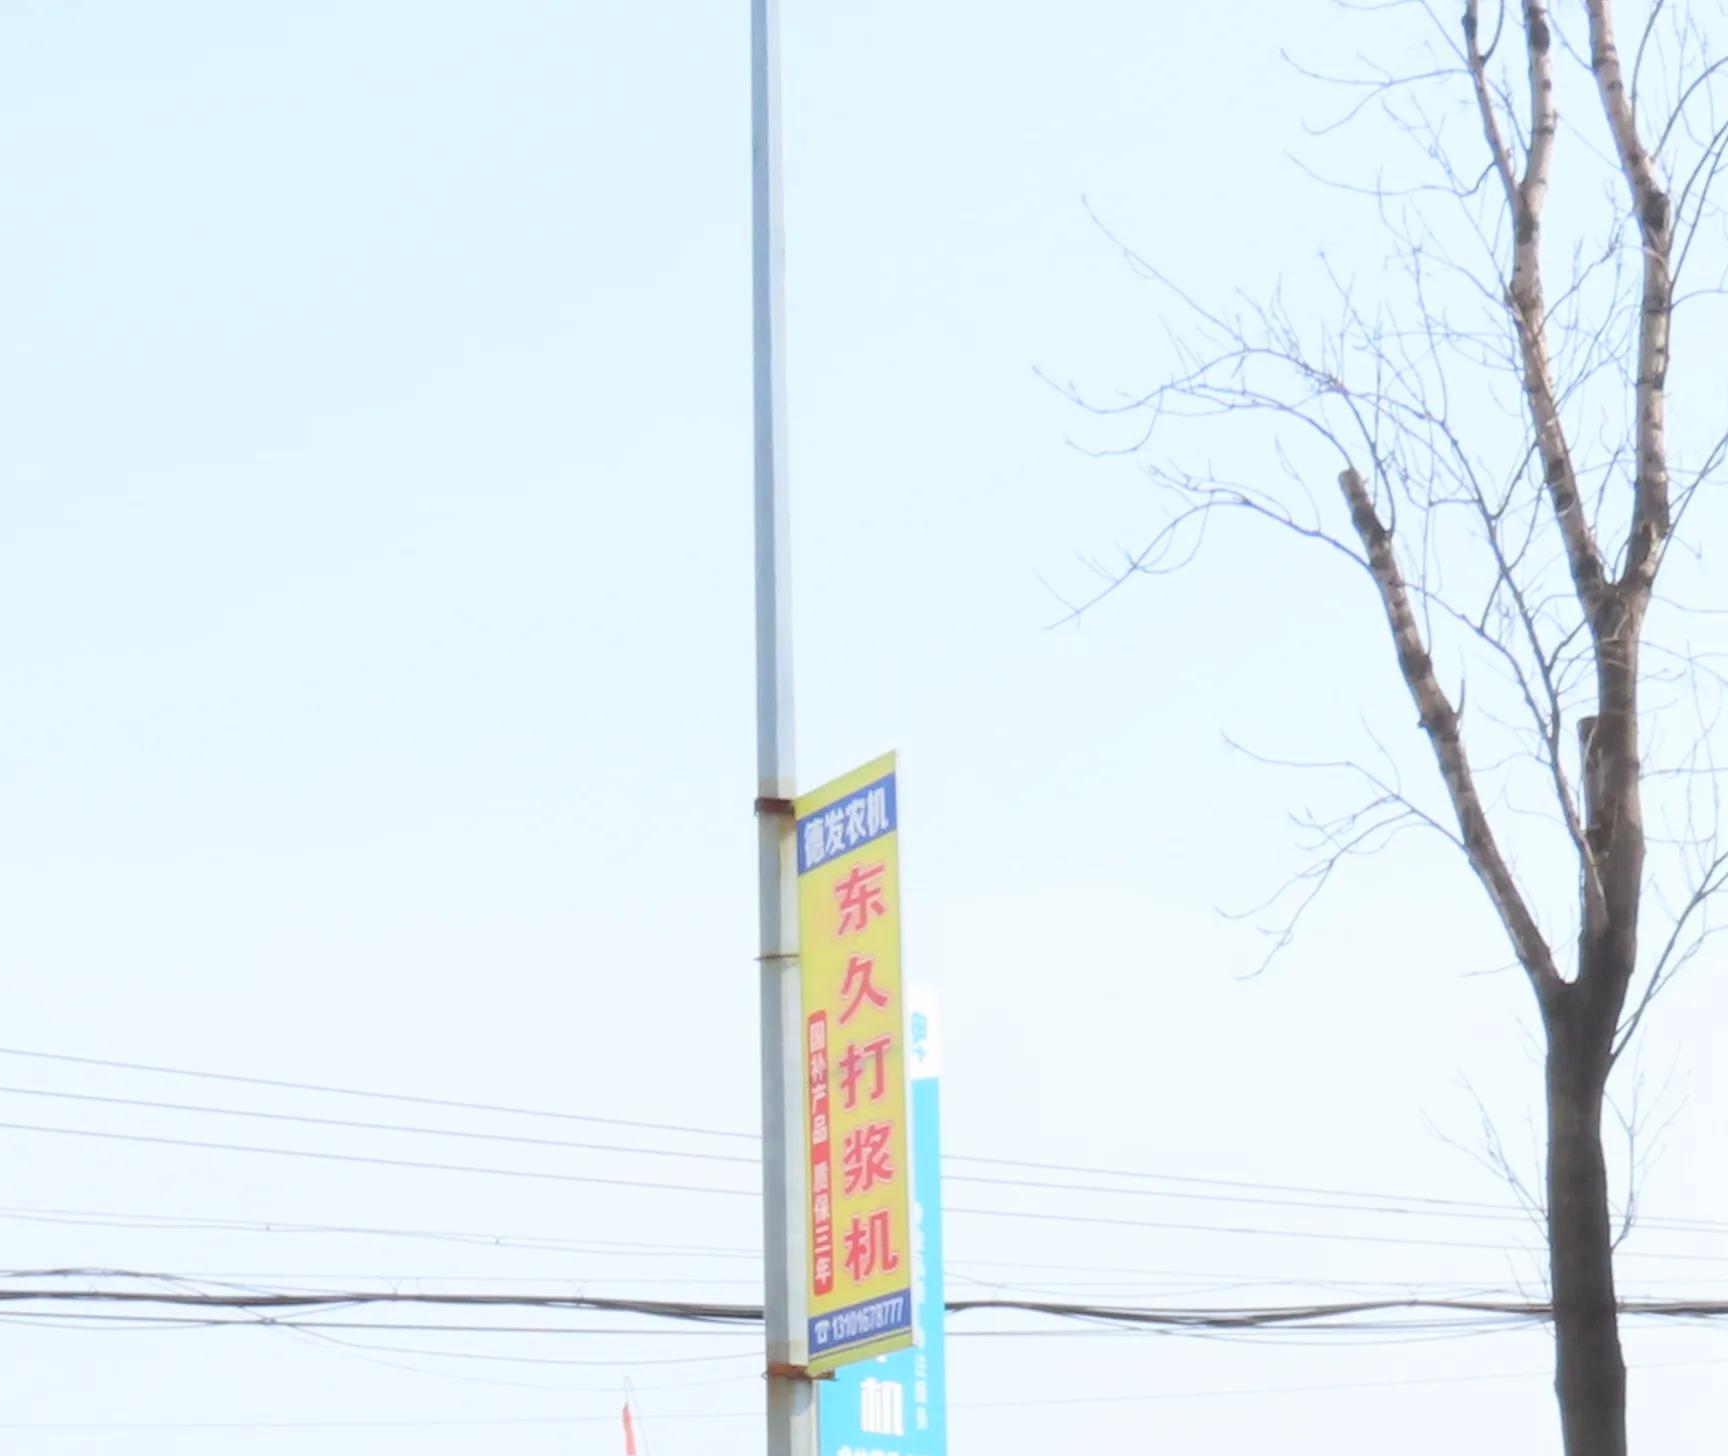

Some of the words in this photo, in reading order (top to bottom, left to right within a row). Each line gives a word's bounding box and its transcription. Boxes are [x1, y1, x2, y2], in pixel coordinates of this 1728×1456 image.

[803, 786, 890, 868] 德发农机
[835, 864, 901, 1283] 东久打浆机
